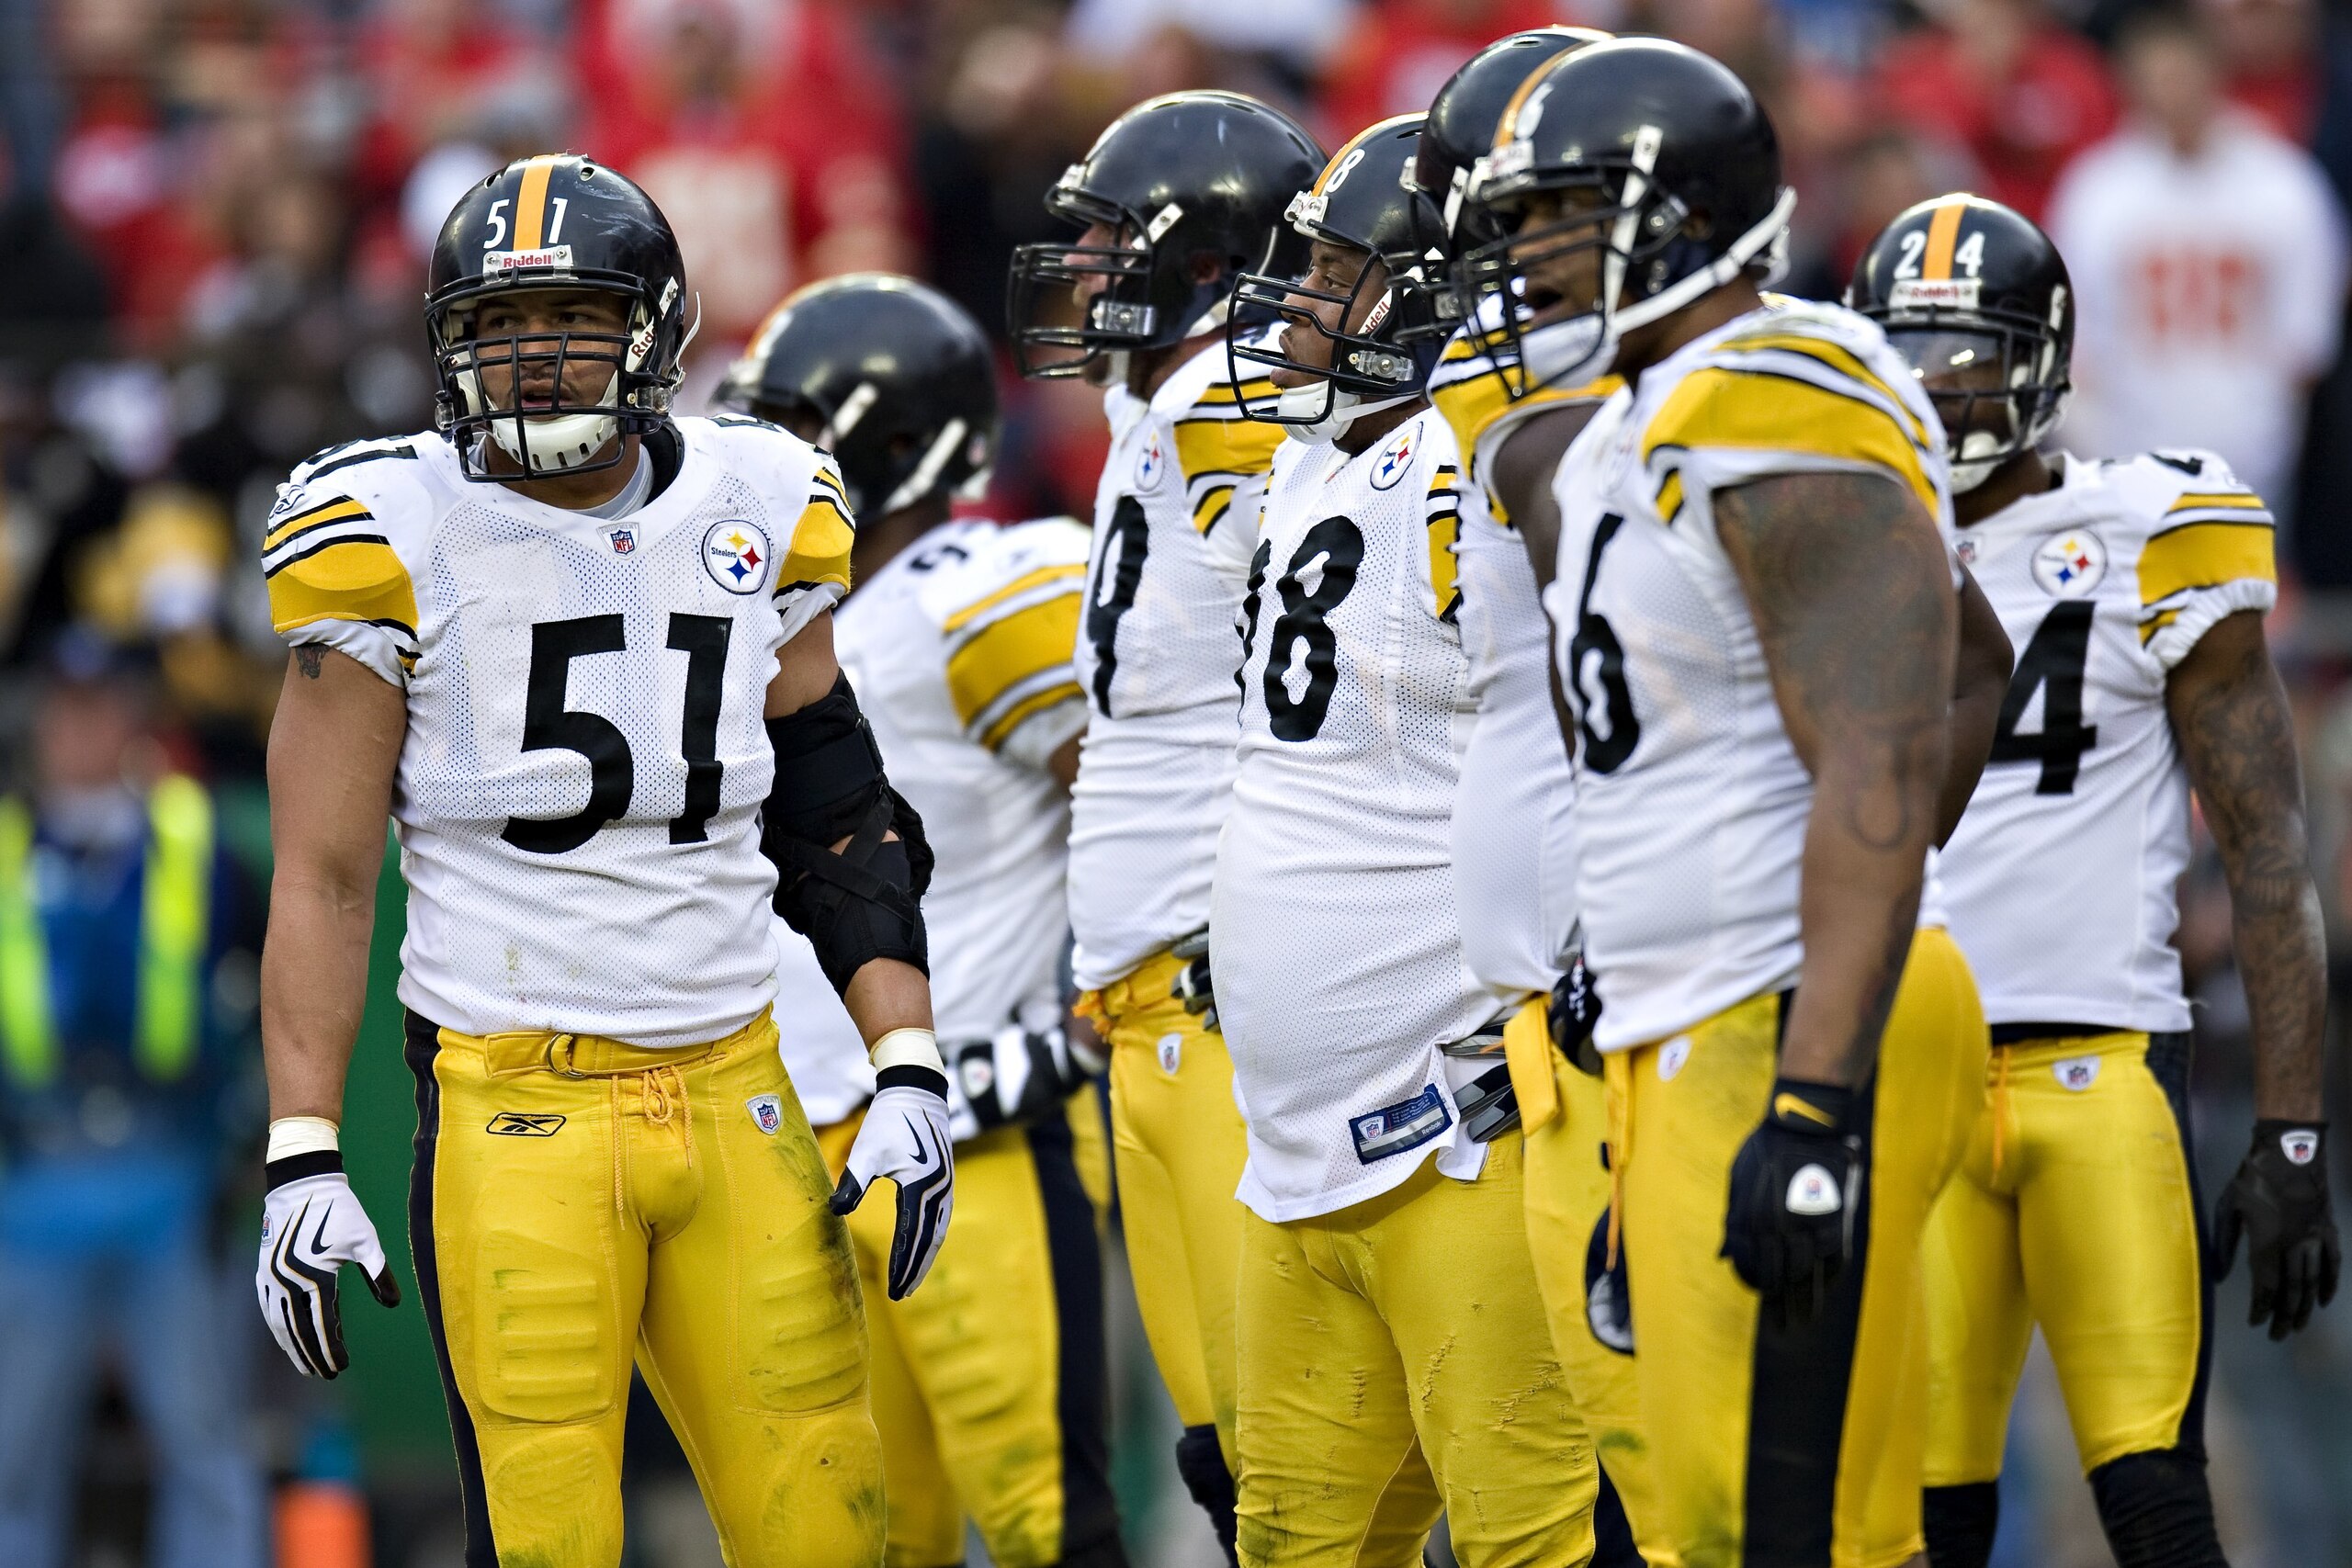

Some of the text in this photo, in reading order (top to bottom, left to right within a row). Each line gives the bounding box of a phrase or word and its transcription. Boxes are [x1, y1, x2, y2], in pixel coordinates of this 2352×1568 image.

[1326, 149, 1366, 193] 8
[503, 254, 552, 268] Riddell
[616, 539, 633, 552] NFL
[711, 547, 738, 558] Steelers
[1571, 513, 1640, 774] 6
[1987, 601, 2098, 795] 4
[500, 611, 734, 854] 51
[762, 1113, 777, 1127] NFL
[1421, 1121, 1442, 1136] Reebok
